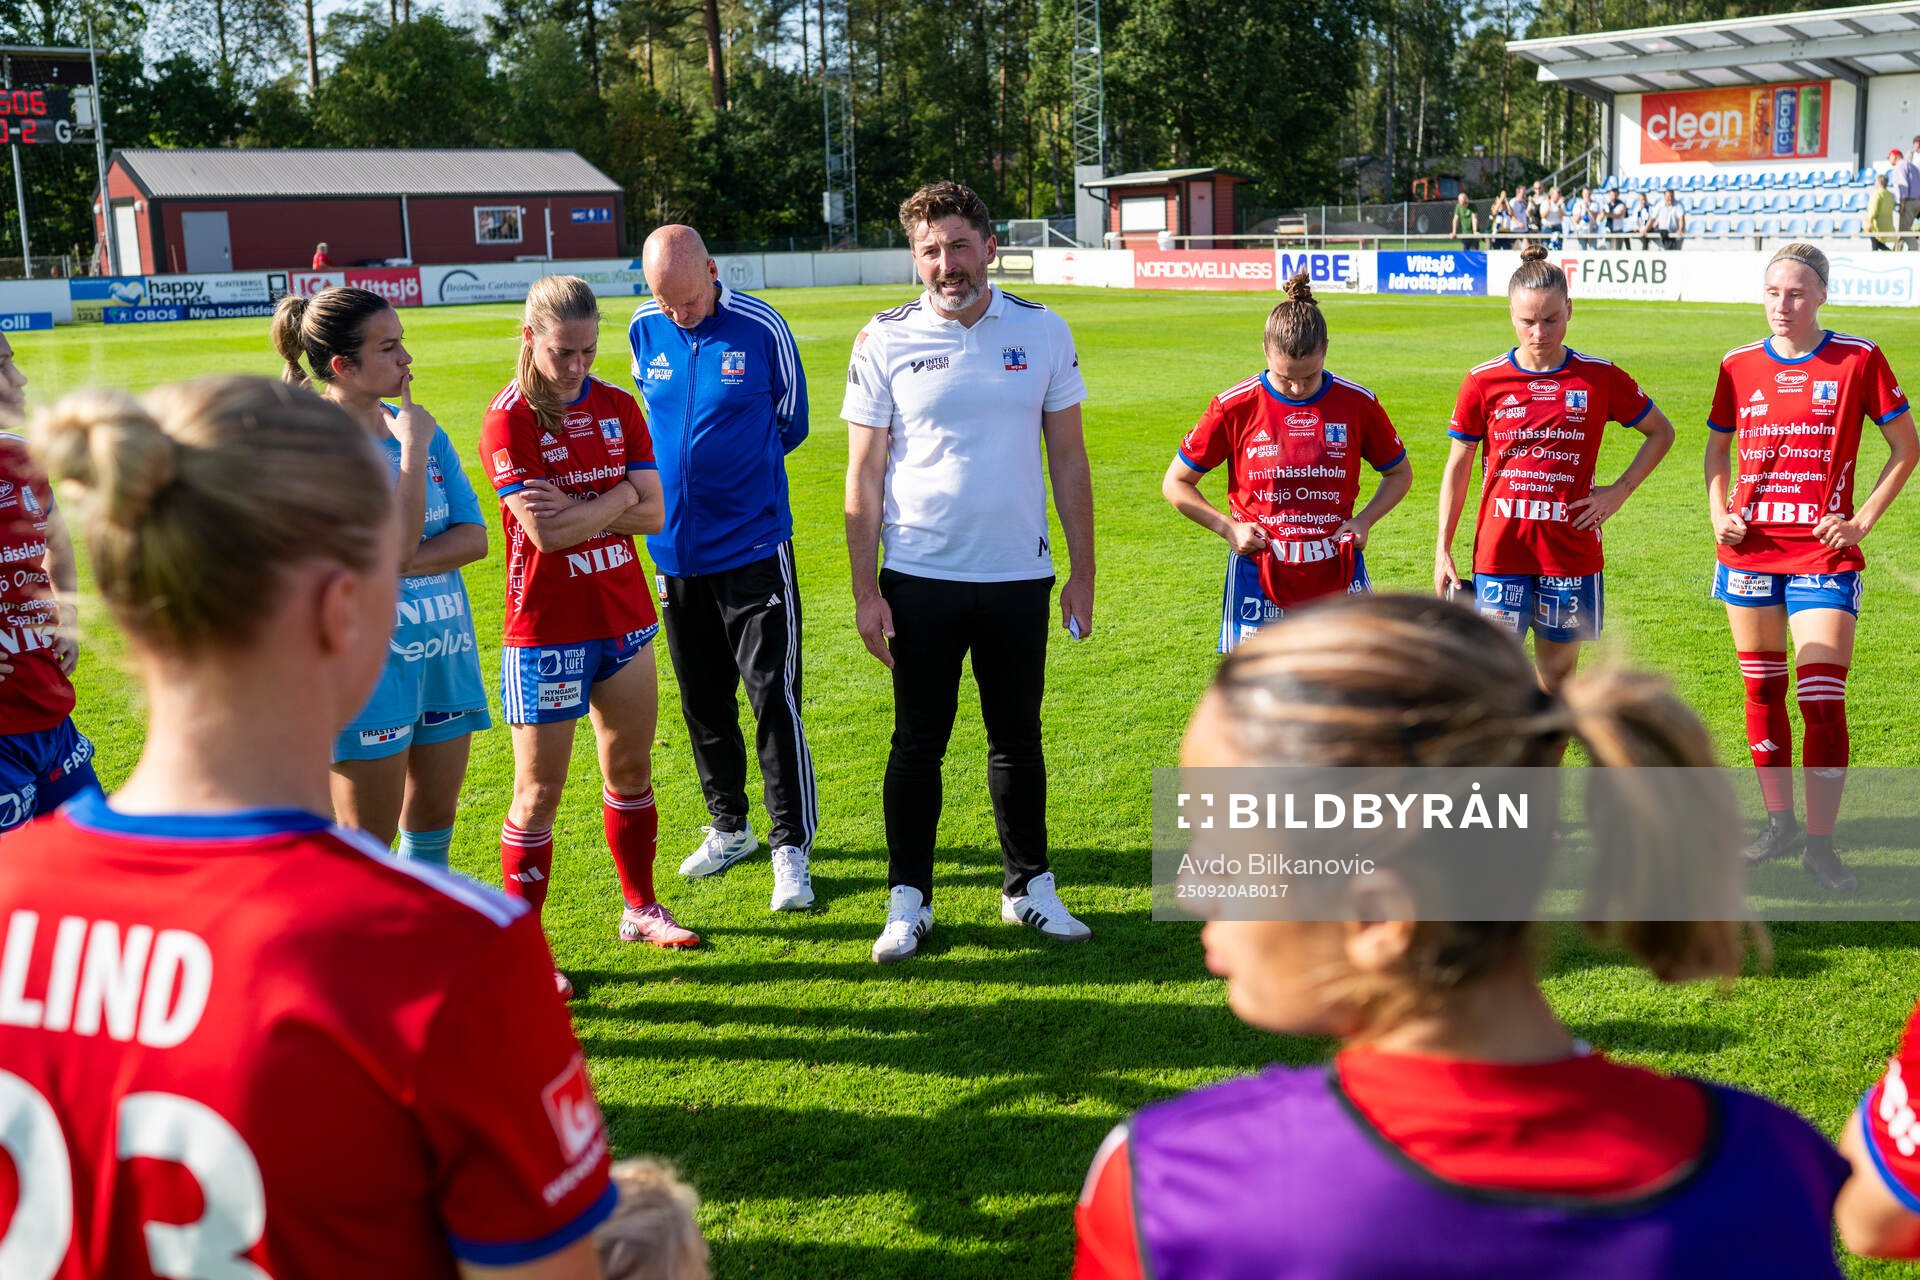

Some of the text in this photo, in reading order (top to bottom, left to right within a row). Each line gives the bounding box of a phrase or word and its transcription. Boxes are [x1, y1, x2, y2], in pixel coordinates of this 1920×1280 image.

[1647, 105, 1743, 140] clean
[55, 119, 72, 144] G
[1282, 253, 1350, 282] MBE
[1406, 254, 1456, 276] Vittsjö
[1582, 258, 1668, 284] FASAB
[148, 279, 205, 295] happy
[1388, 272, 1474, 294] Idrottspark
[134, 309, 177, 321] OBOS
[189, 307, 216, 320] Nya
[925, 356, 949, 365] INTER
[926, 362, 950, 371] SPORT
[1506, 411, 1525, 419] SPORT
[1739, 421, 1836, 439] #mitthässleholm
[1531, 446, 1580, 465] Omsorg
[1778, 444, 1832, 462] Omsorg
[1247, 464, 1346, 481] #mitthässleholm
[1509, 480, 1555, 493] Sparbank
[1755, 483, 1801, 494] Sparbank
[1295, 487, 1340, 505] Omsorg
[1492, 497, 1570, 522] NIBE
[1278, 526, 1327, 537] Sparbank
[1538, 575, 1583, 587] FASAB
[1505, 591, 1523, 603] LUFT
[1568, 595, 1579, 613] 3
[564, 657, 585, 670] LUFT
[0, 908, 214, 1050] LIND
